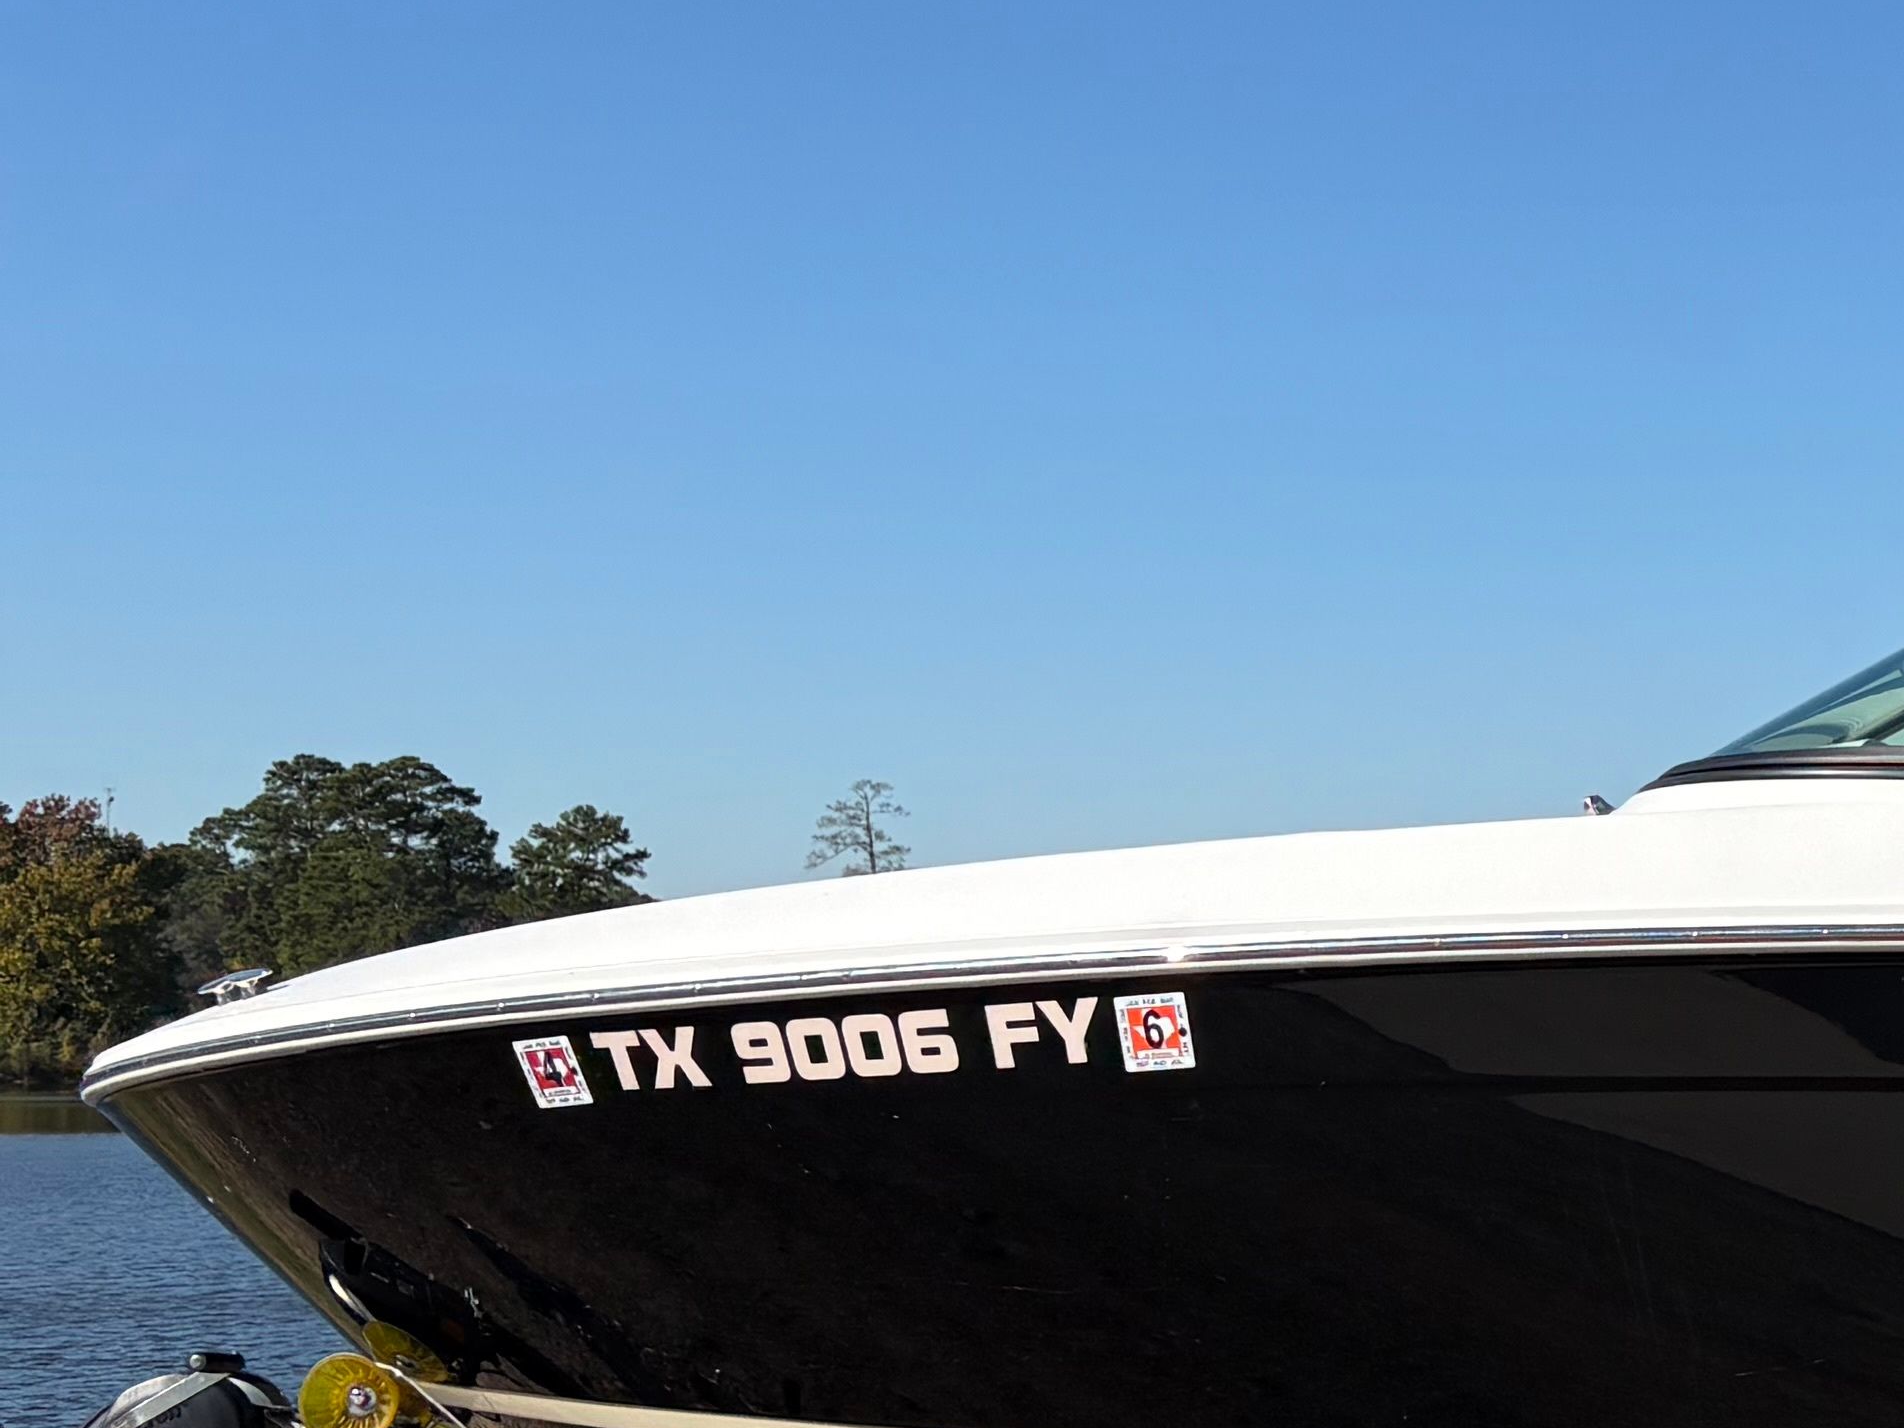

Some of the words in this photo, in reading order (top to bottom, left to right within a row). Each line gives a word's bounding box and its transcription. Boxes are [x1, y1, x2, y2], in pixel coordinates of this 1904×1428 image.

[589, 1025, 713, 1091] TX
[730, 1008, 960, 1085] 9006
[984, 996, 1099, 1069] FY
[1142, 1008, 1165, 1050] 6
